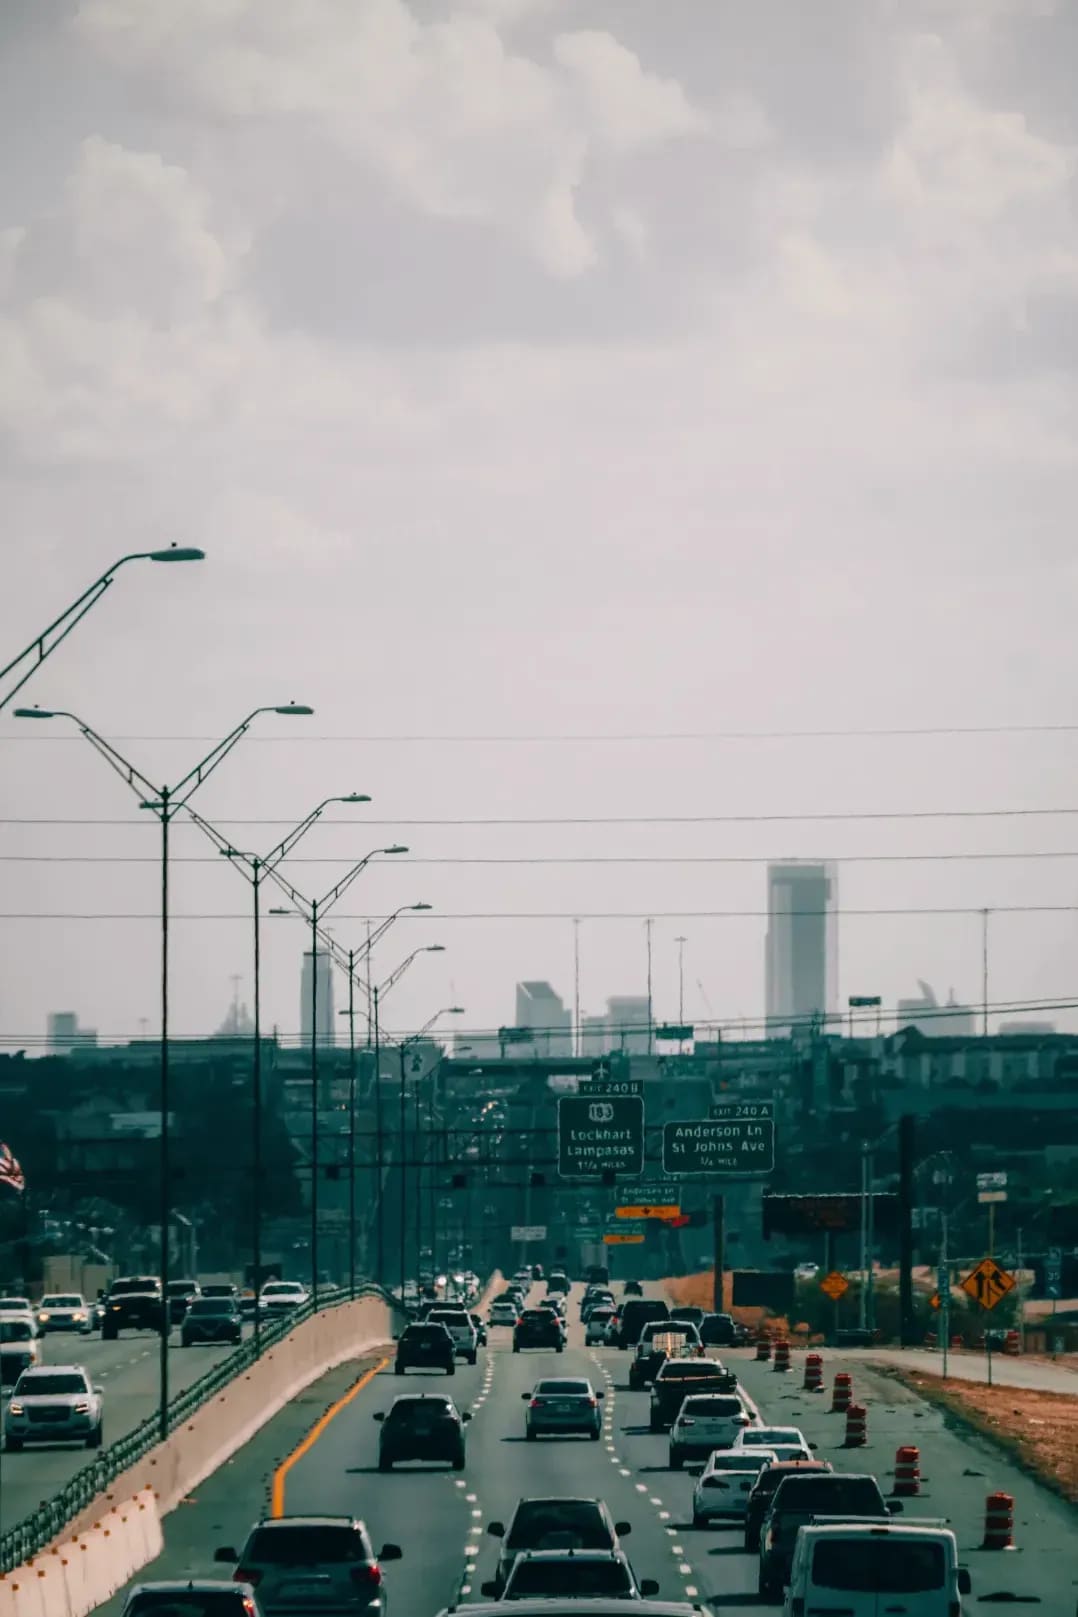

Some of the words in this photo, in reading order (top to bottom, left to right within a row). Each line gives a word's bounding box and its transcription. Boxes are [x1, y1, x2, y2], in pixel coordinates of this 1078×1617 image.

[605, 1082, 629, 1094] 240
[735, 1106, 757, 1117] 240
[760, 1106, 769, 1116] A
[570, 1129, 632, 1141] Lockhart
[675, 1125, 740, 1137] Anderson
[747, 1124, 762, 1135] Ln
[567, 1145, 635, 1158] Lampasas
[672, 1142, 686, 1153] St
[693, 1141, 734, 1152] Johns
[740, 1140, 766, 1152] Ave
